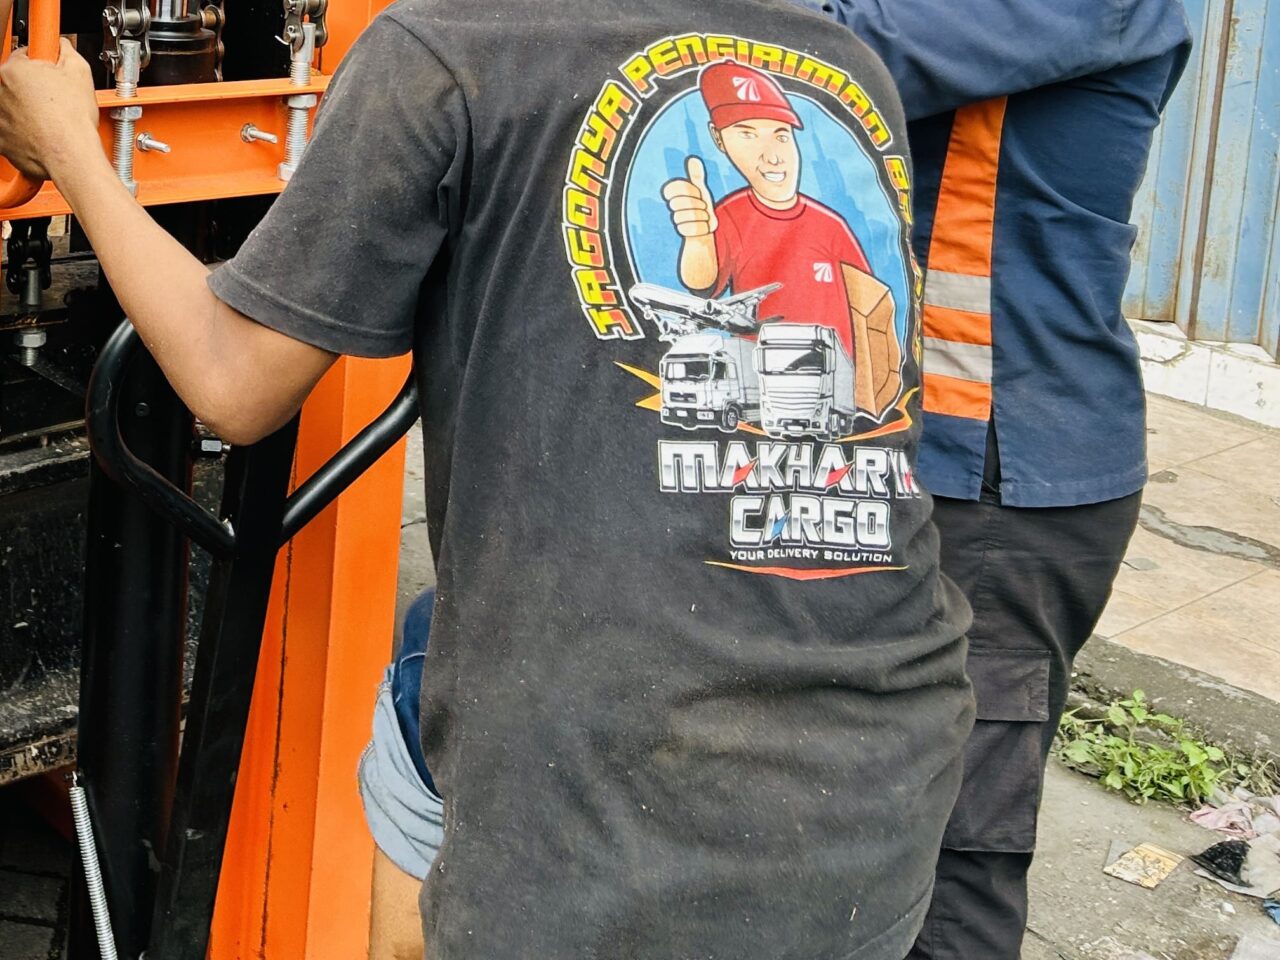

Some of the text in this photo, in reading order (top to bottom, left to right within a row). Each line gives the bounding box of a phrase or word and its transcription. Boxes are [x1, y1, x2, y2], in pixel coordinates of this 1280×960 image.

[562, 32, 893, 340] JAGONYA PENGIRIMAN
[730, 493, 892, 551] CARGO
[729, 549, 892, 562] YOUR DELIVERY SOLUTION
